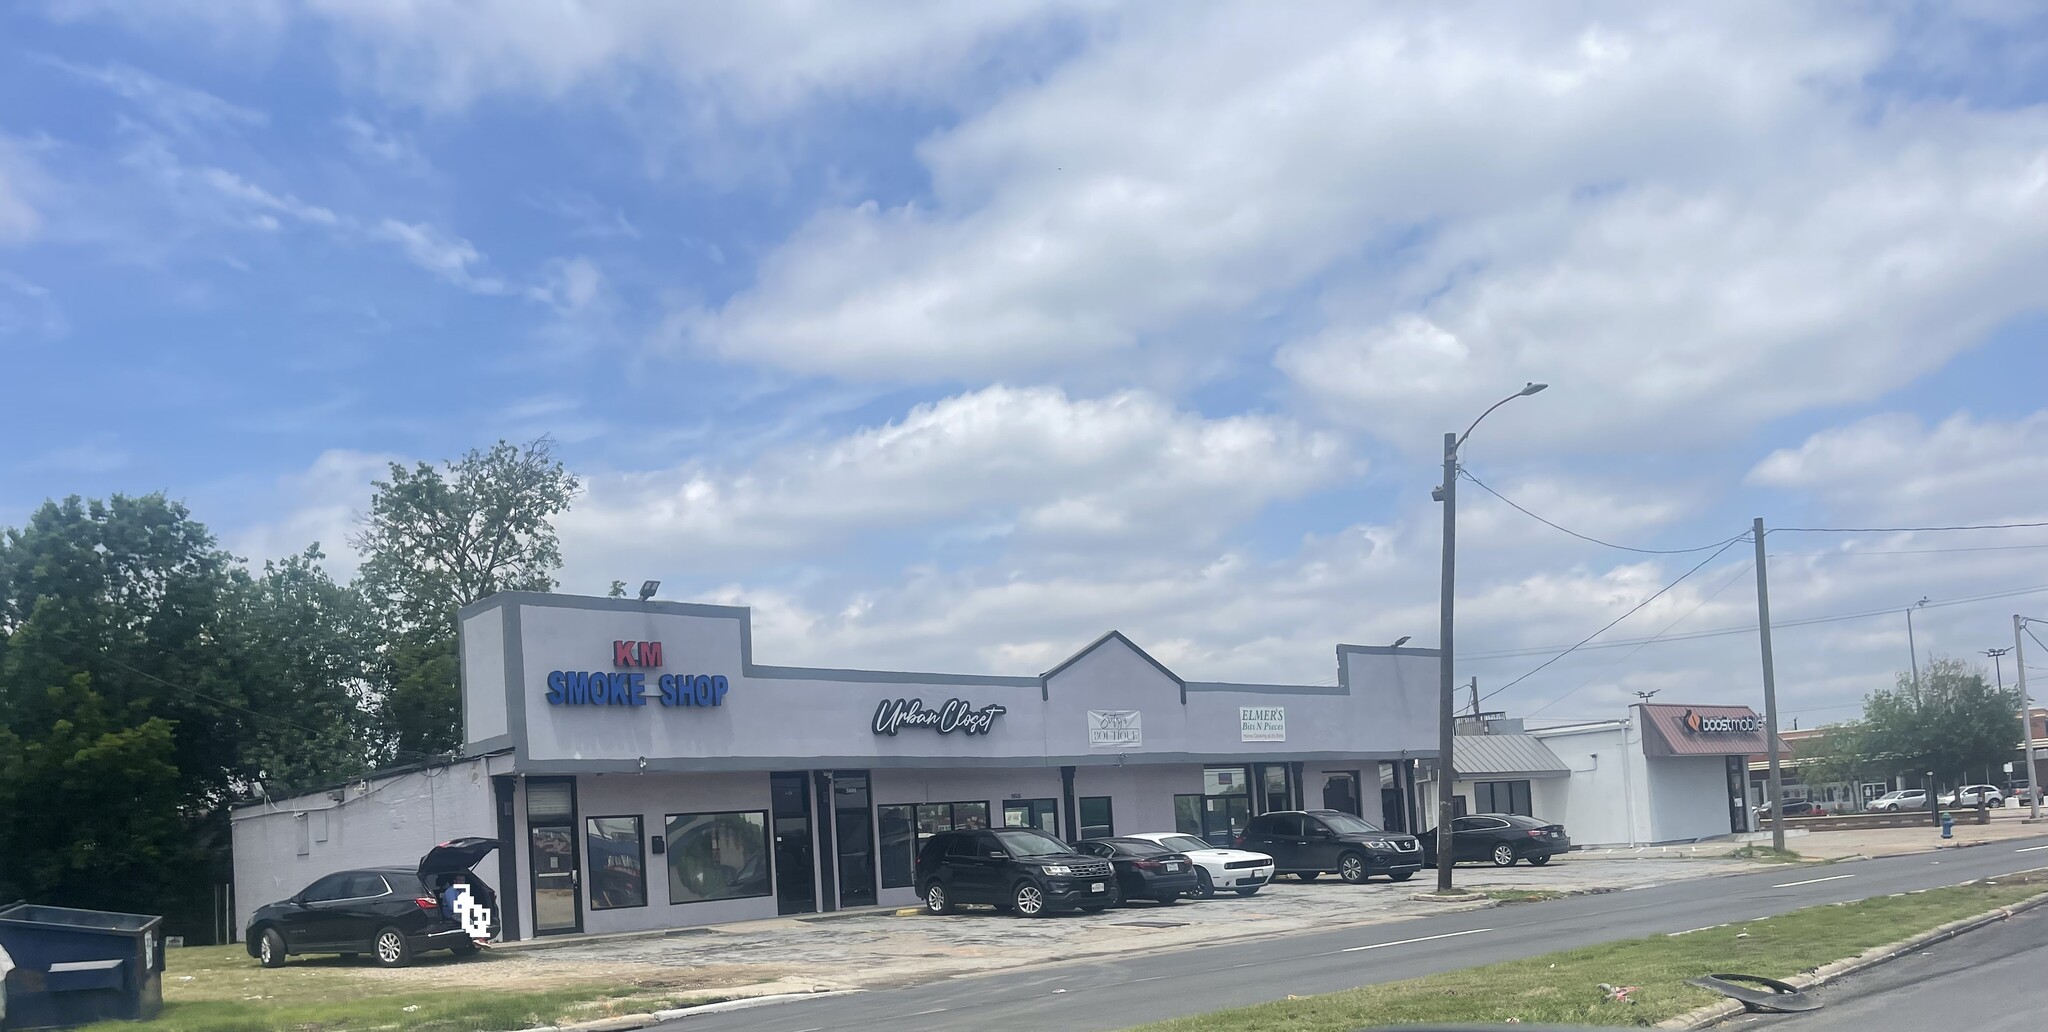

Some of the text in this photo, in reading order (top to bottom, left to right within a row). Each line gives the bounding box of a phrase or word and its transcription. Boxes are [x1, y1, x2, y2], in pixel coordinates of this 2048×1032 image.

[613, 640, 663, 667] KM
[546, 671, 728, 706] SMOKE SHOP
[874, 699, 1005, 735] Urban Closet
[1242, 709, 1283, 721] ELMER'S
[1242, 722, 1283, 730] Bits N Pieces
